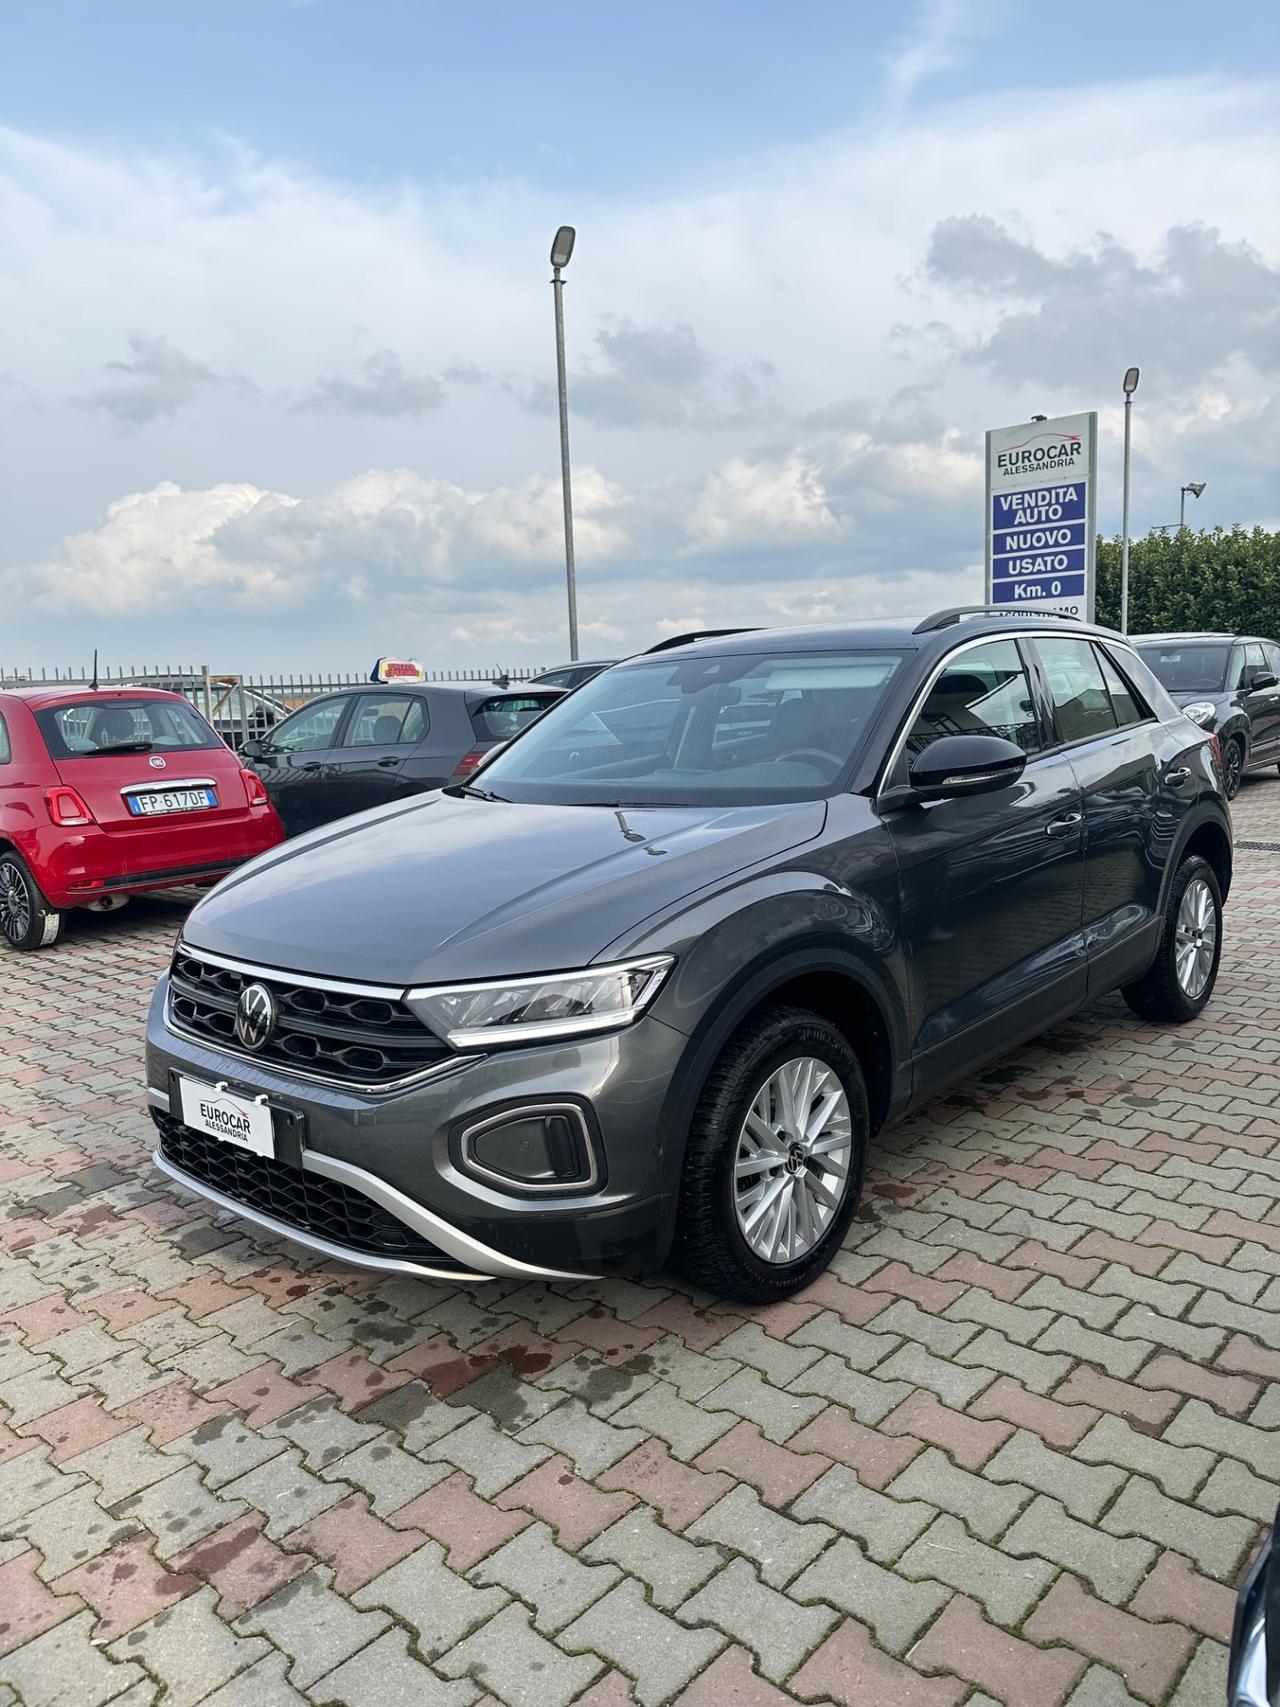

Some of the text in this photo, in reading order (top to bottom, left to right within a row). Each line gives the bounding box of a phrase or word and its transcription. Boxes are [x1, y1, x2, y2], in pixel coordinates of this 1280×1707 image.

[997, 441, 1082, 468] EUROCAR
[1003, 457, 1075, 476] ALESSANDRIA
[1000, 486, 1078, 511] VENDITA
[1014, 504, 1062, 525] AUTO
[1005, 528, 1072, 551] NUOVO
[1008, 554, 1068, 575] USATO
[1014, 580, 1061, 599] Km. 0
[200, 1102, 252, 1135] EUROCAR
[204, 1119, 249, 1143] ALESSANDRIA
